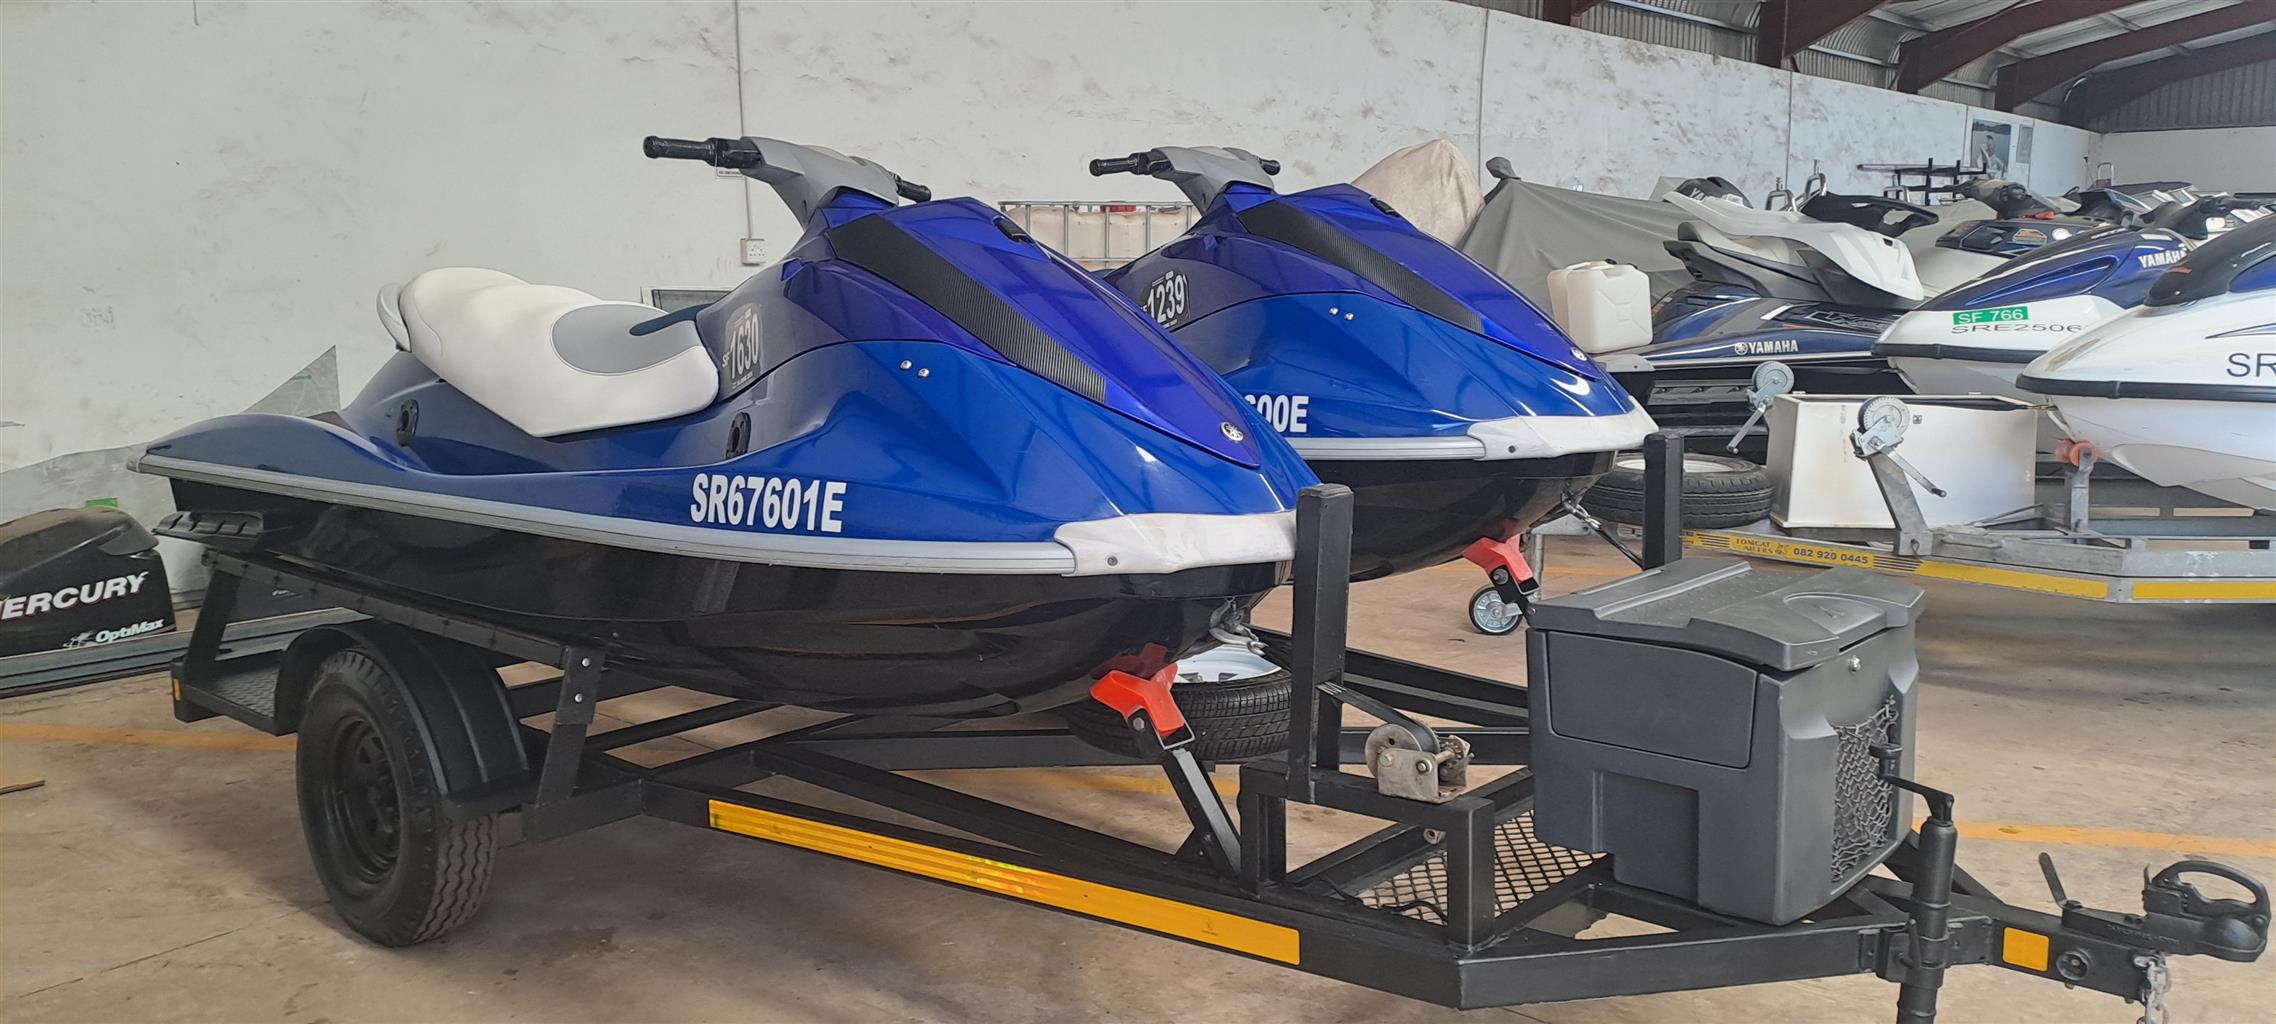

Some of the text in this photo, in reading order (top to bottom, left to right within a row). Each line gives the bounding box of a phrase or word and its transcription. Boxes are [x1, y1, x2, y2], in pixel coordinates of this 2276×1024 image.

[1148, 275, 1185, 323] 1239
[1958, 309, 2023, 324] SF 766
[1952, 324, 2089, 334] SRE2506
[730, 313, 759, 379] 1630
[1749, 340, 1798, 354] YAMAHA
[2226, 353, 2276, 377] SR
[691, 473, 847, 533] SR67601E
[1793, 548, 1868, 563] 082 920 0445
[0, 571, 149, 620] ERCURY
[96, 619, 164, 643] OptiMax
